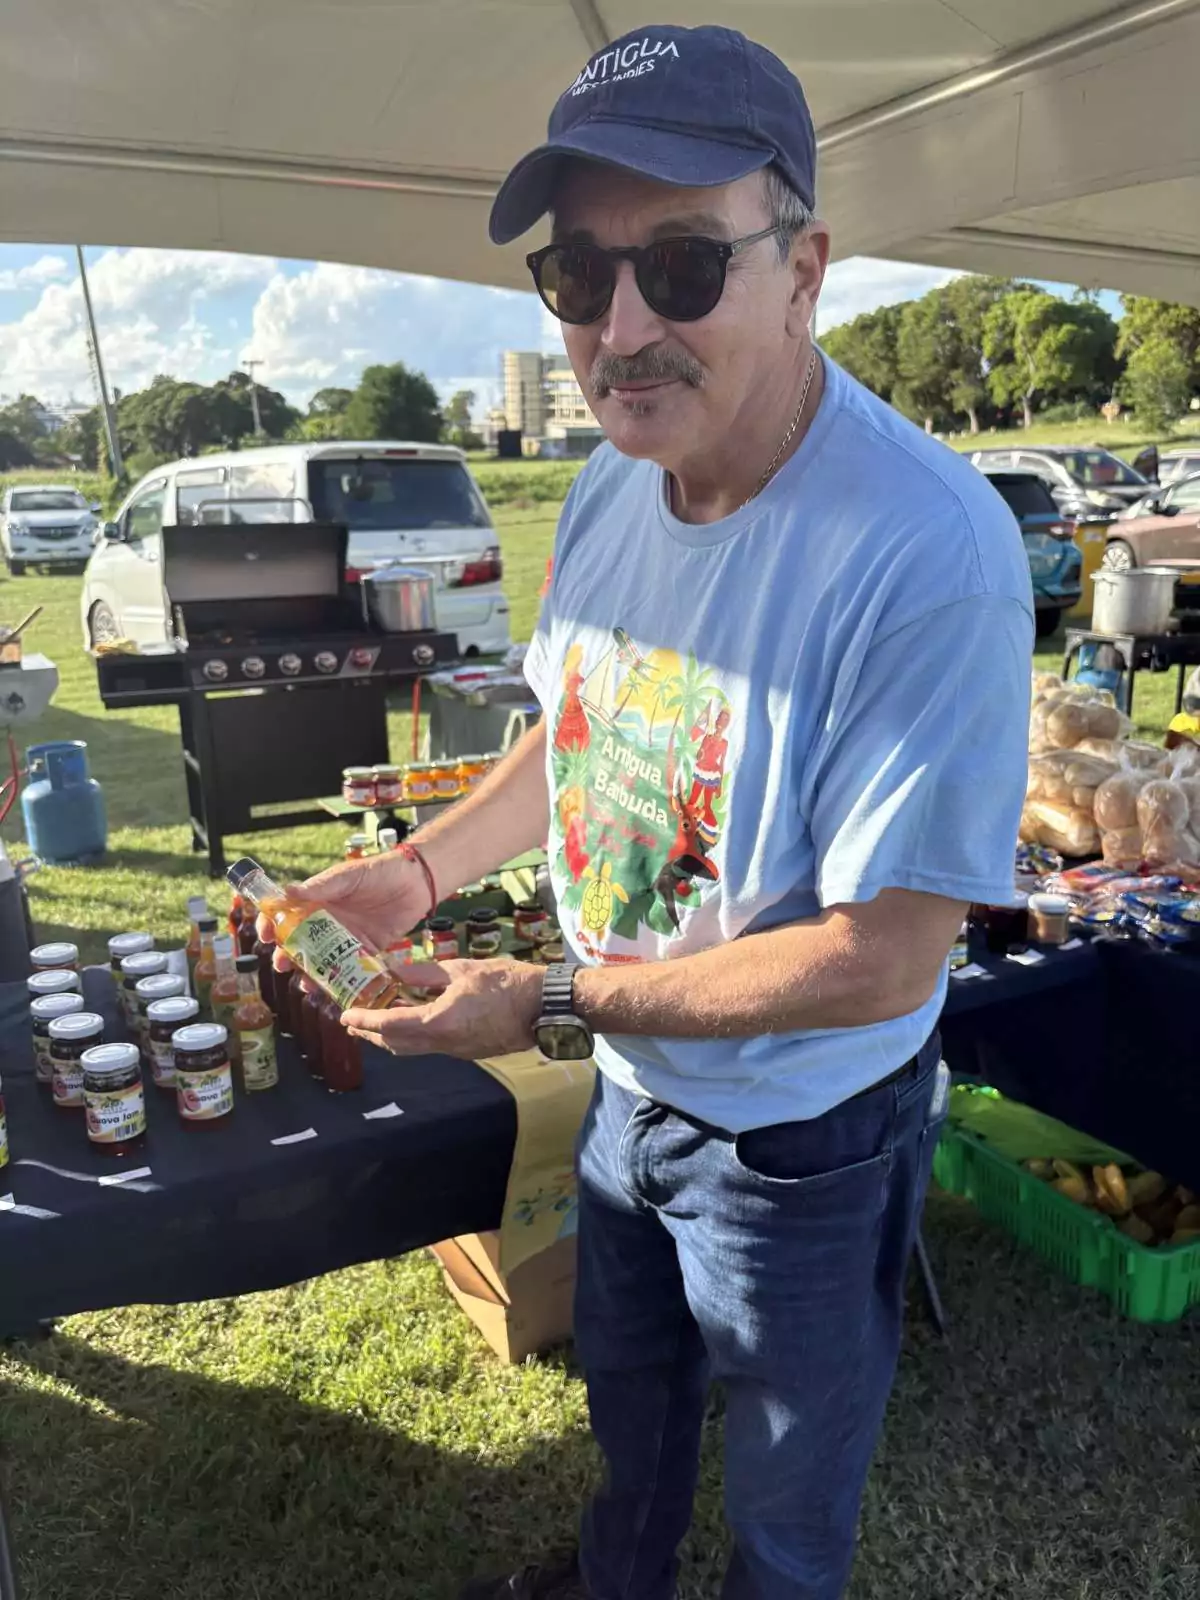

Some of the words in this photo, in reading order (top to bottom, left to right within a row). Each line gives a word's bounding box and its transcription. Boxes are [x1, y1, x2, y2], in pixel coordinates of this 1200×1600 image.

[602, 735, 662, 787] Angua
[594, 768, 669, 827] Babuda
[90, 1113, 120, 1124] Guava
